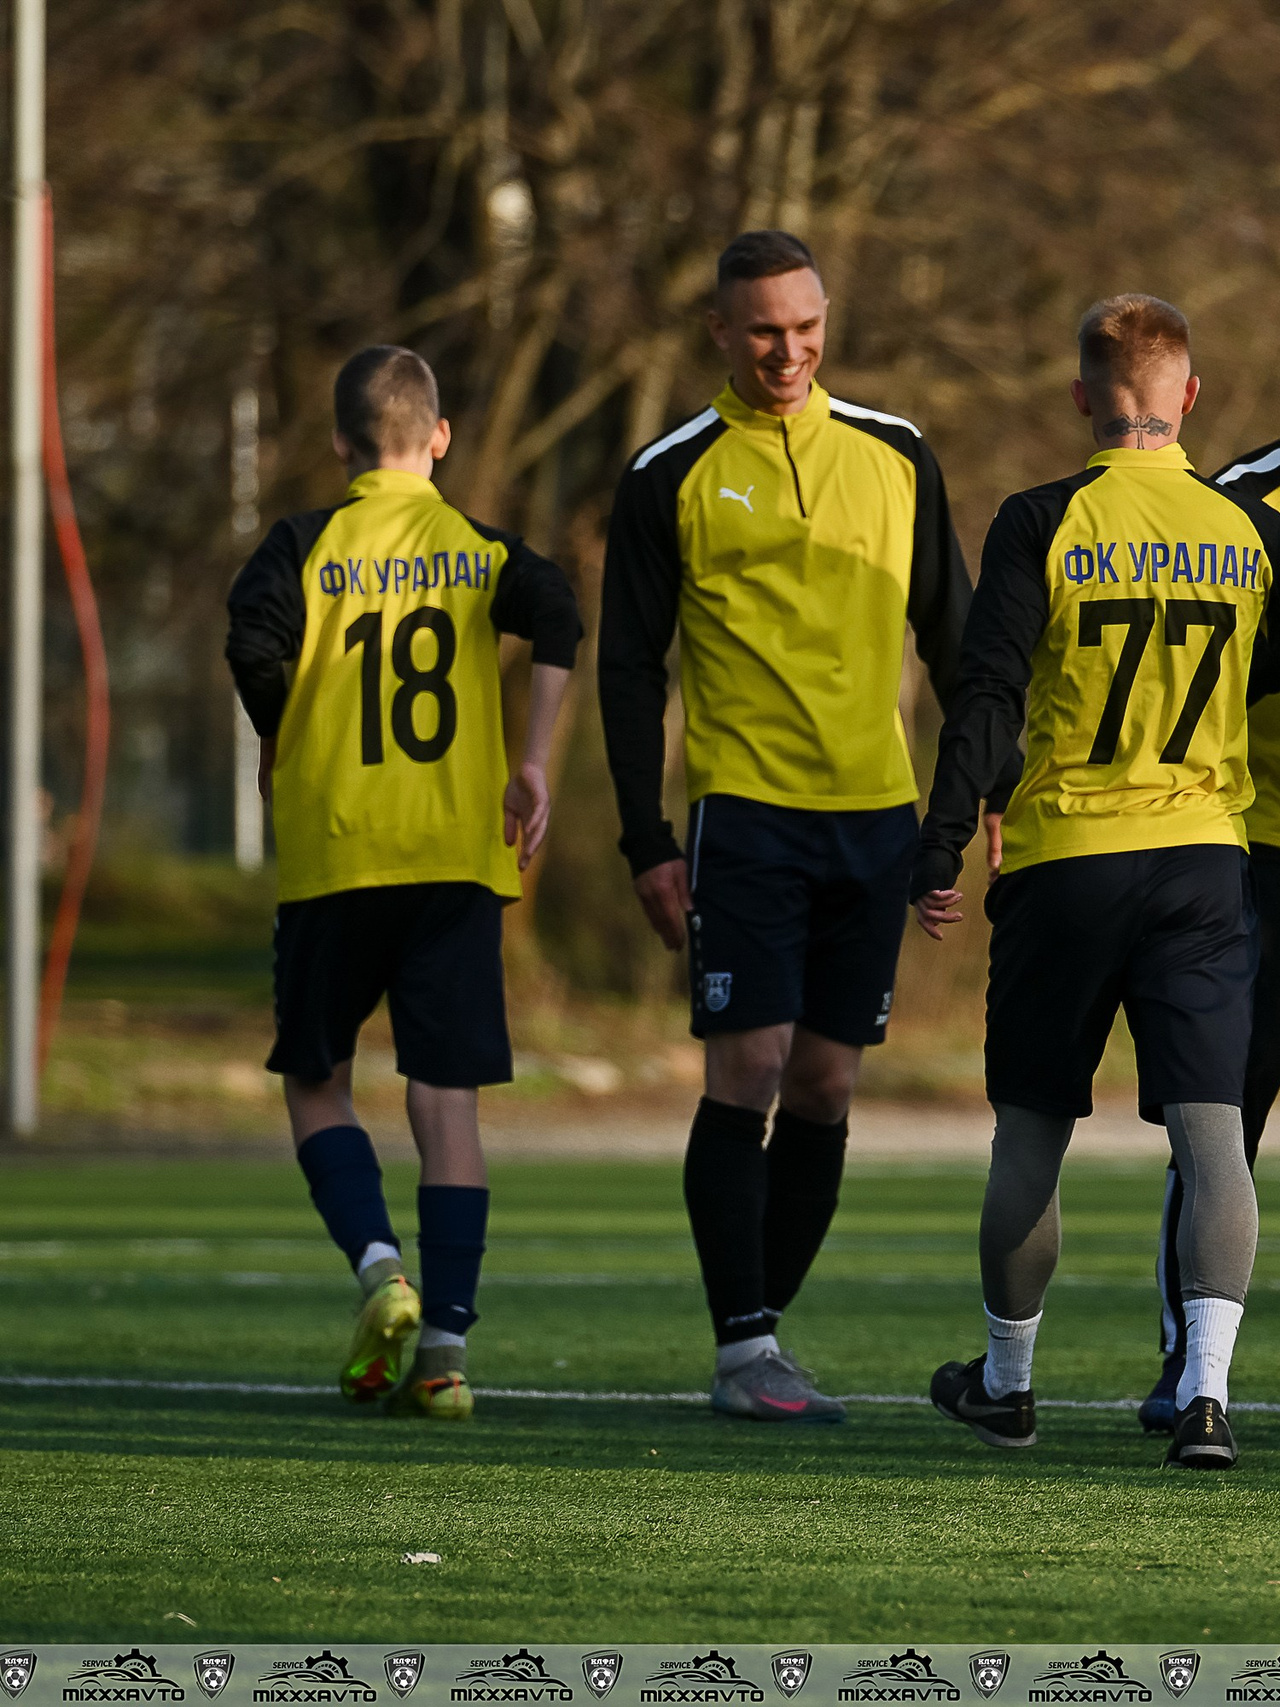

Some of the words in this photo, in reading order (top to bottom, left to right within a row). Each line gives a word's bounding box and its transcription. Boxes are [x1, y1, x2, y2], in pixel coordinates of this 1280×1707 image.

[319, 558, 365, 598] ФК
[374, 551, 492, 595] УРАЛАН
[1064, 542, 1120, 585] ФК
[1127, 541, 1262, 590] УРАЛАН
[344, 606, 458, 766] 18
[1077, 598, 1237, 765] 77
